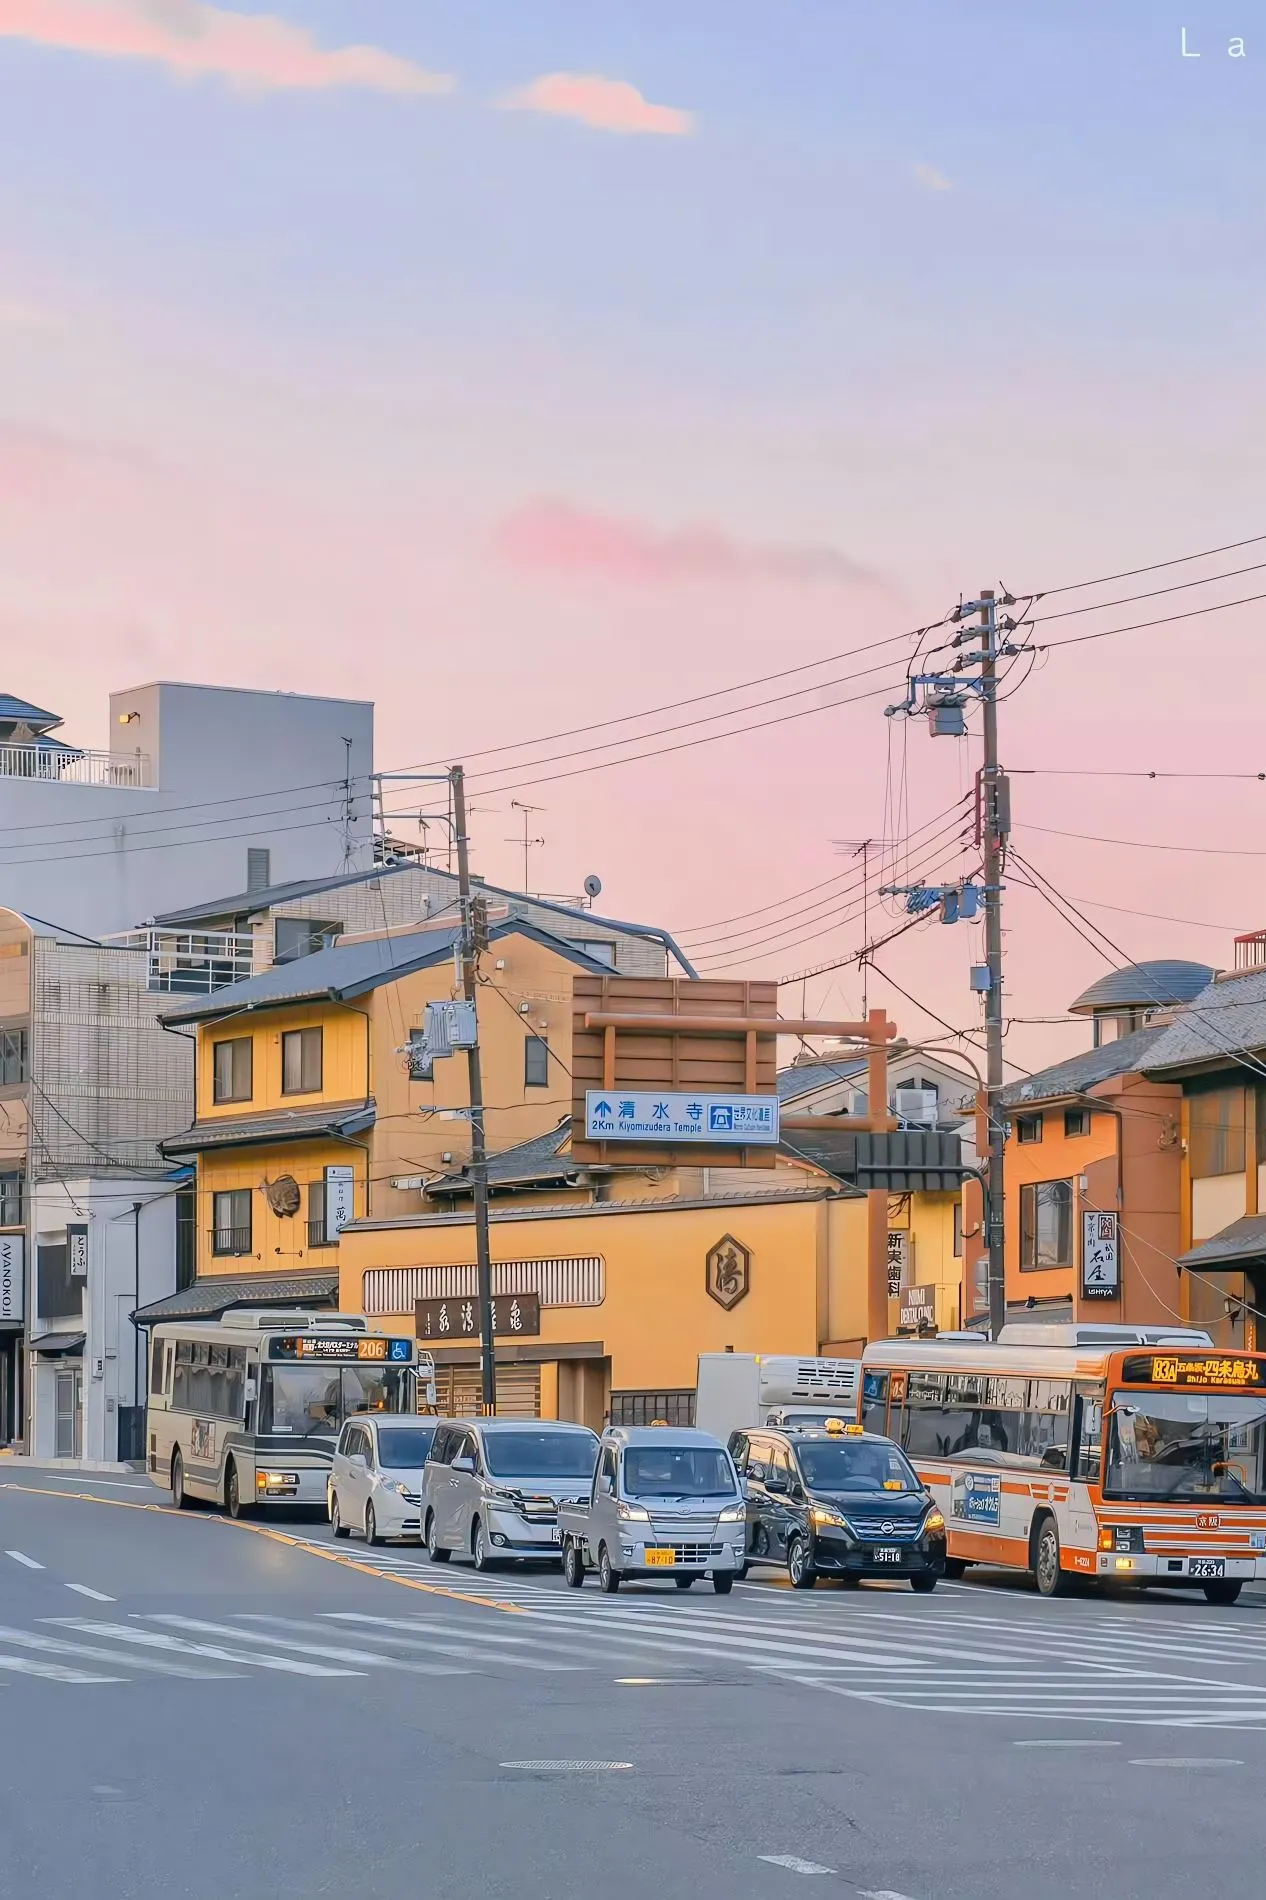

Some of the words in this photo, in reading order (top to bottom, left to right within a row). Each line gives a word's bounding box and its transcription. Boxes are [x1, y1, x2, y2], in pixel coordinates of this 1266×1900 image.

[618, 1100, 703, 1121] 清水寺
[592, 1120, 614, 1131] 2Km
[618, 1120, 671, 1133] Kiyomizudera
[674, 1122, 702, 1133] Temple
[77, 1236, 86, 1267] とうふ
[1, 1242, 12, 1316] AYANOKOJI
[359, 1341, 383, 1357] 206
[1198, 1516, 1218, 1527] 京阪
